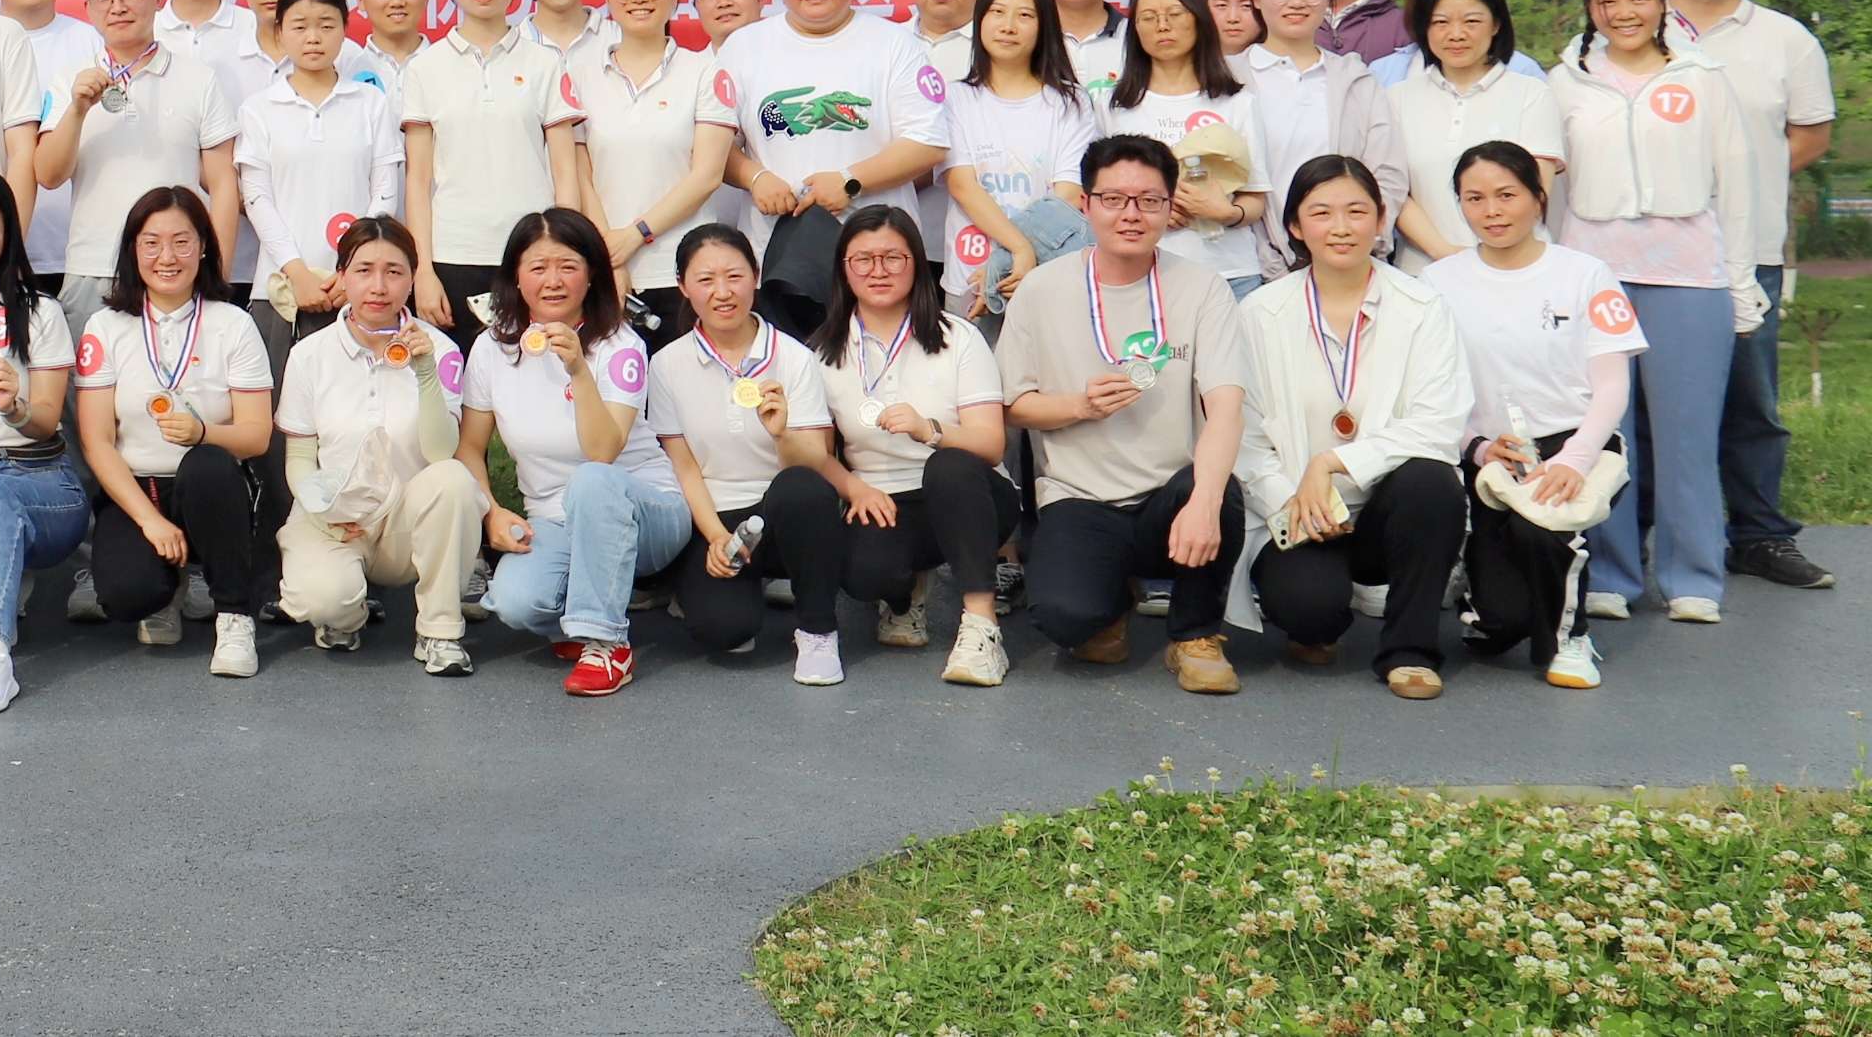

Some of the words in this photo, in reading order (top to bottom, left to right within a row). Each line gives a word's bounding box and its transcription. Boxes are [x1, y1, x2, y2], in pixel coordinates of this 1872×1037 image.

[918, 72, 942, 97] 15
[1657, 92, 1689, 115] 17
[960, 233, 986, 259] 18
[1593, 297, 1630, 328] 18
[79, 342, 94, 367] 3
[447, 360, 462, 385] 7
[622, 358, 639, 383] 6
